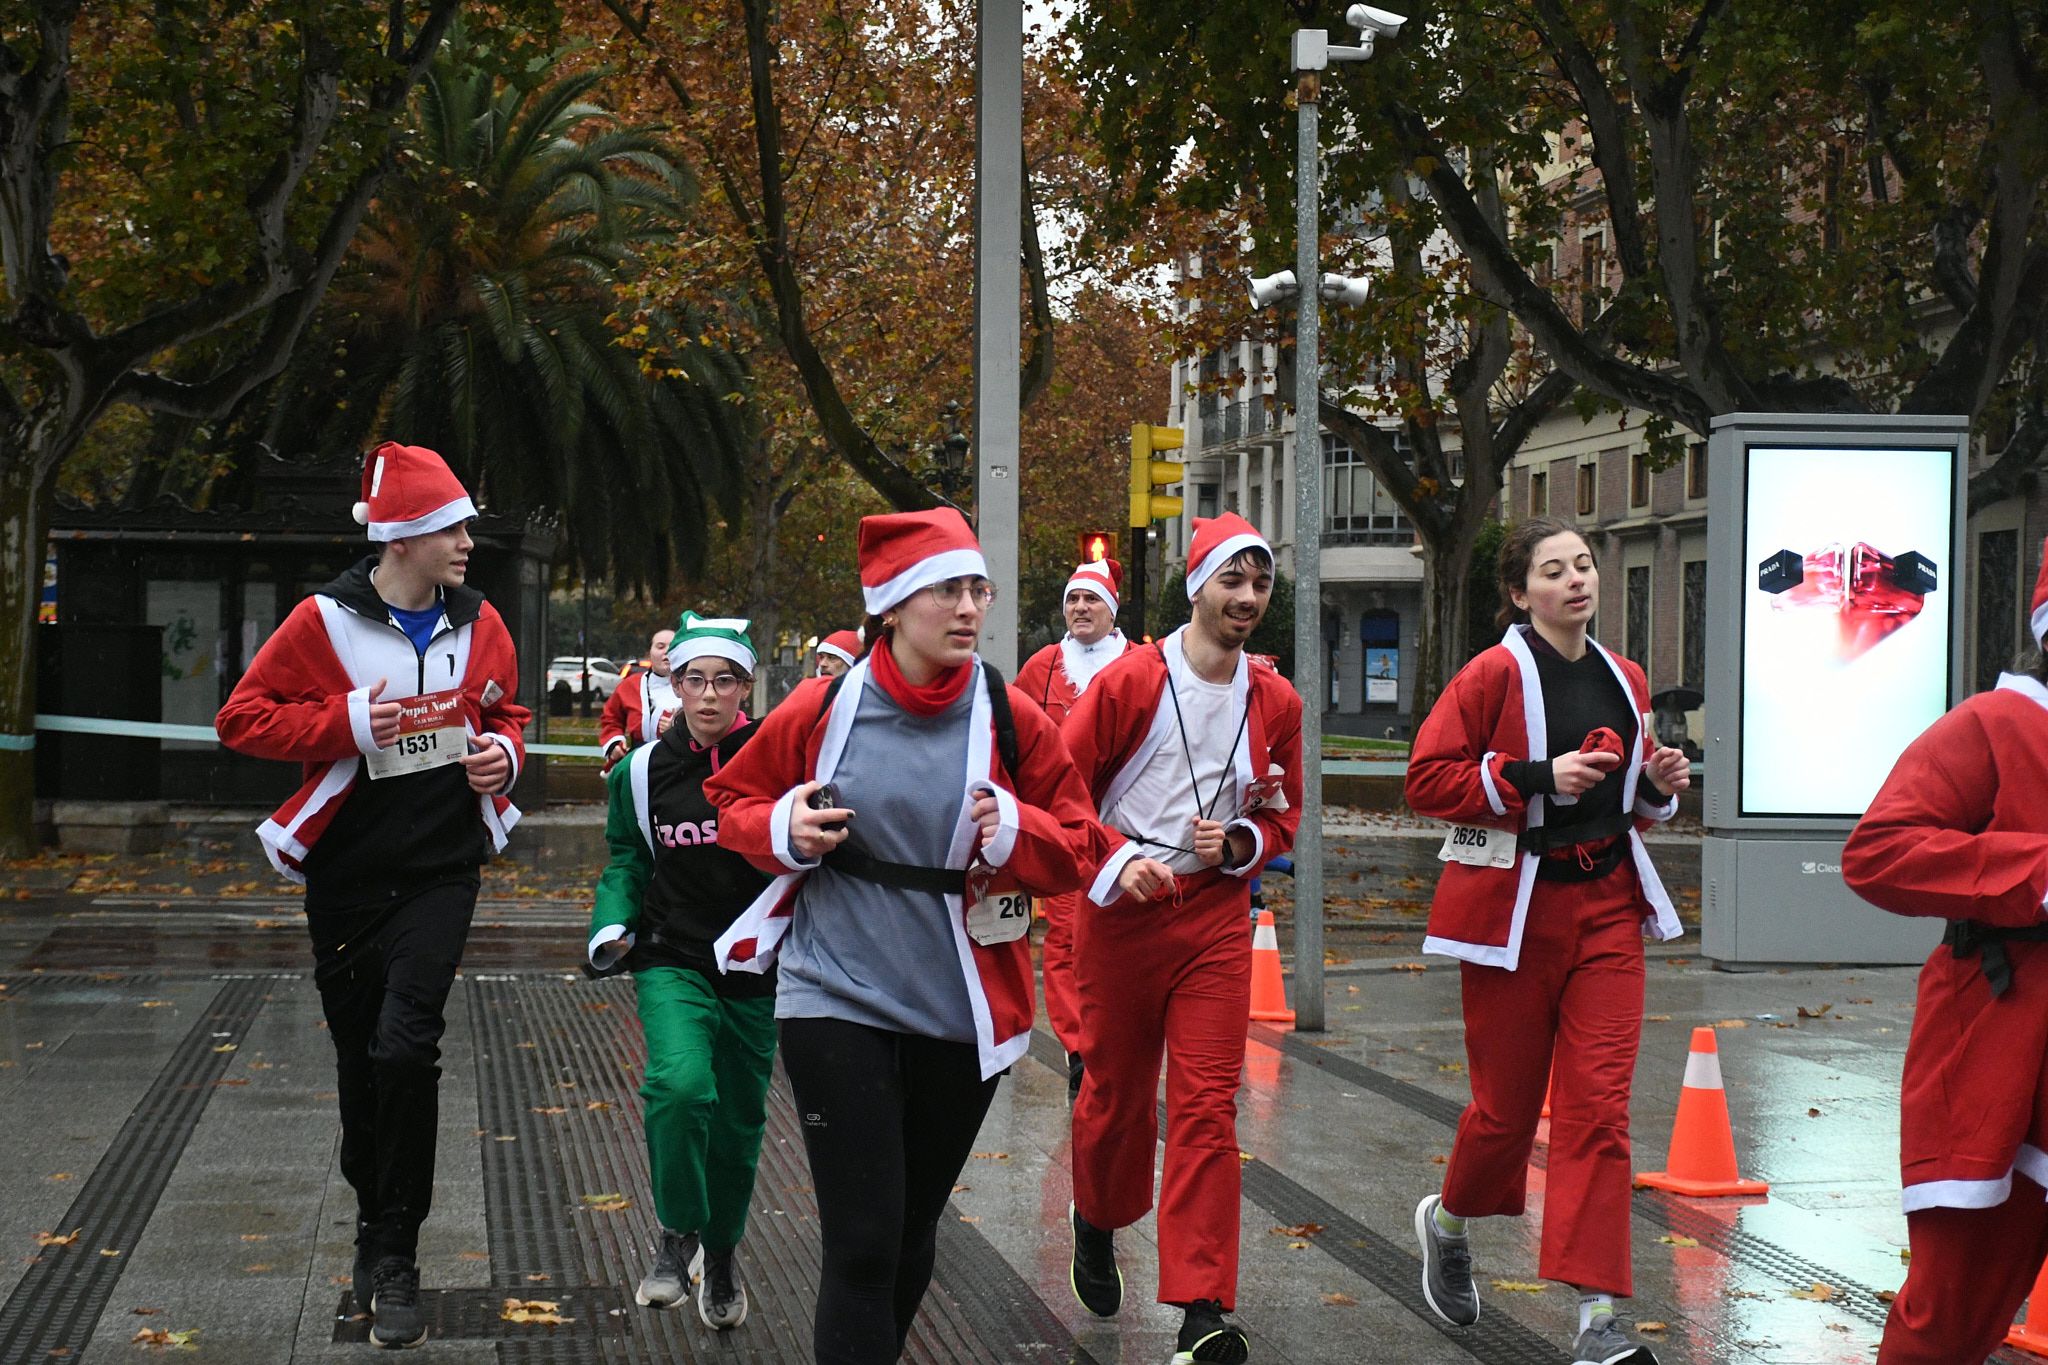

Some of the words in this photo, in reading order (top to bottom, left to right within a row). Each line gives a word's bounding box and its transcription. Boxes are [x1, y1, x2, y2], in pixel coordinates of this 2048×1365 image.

[1760, 561, 1780, 577] PRADA
[1917, 562, 1937, 579] PRADA
[431, 697, 458, 713] Noel
[395, 732, 438, 756] 1531
[1452, 826, 1488, 848] 2626
